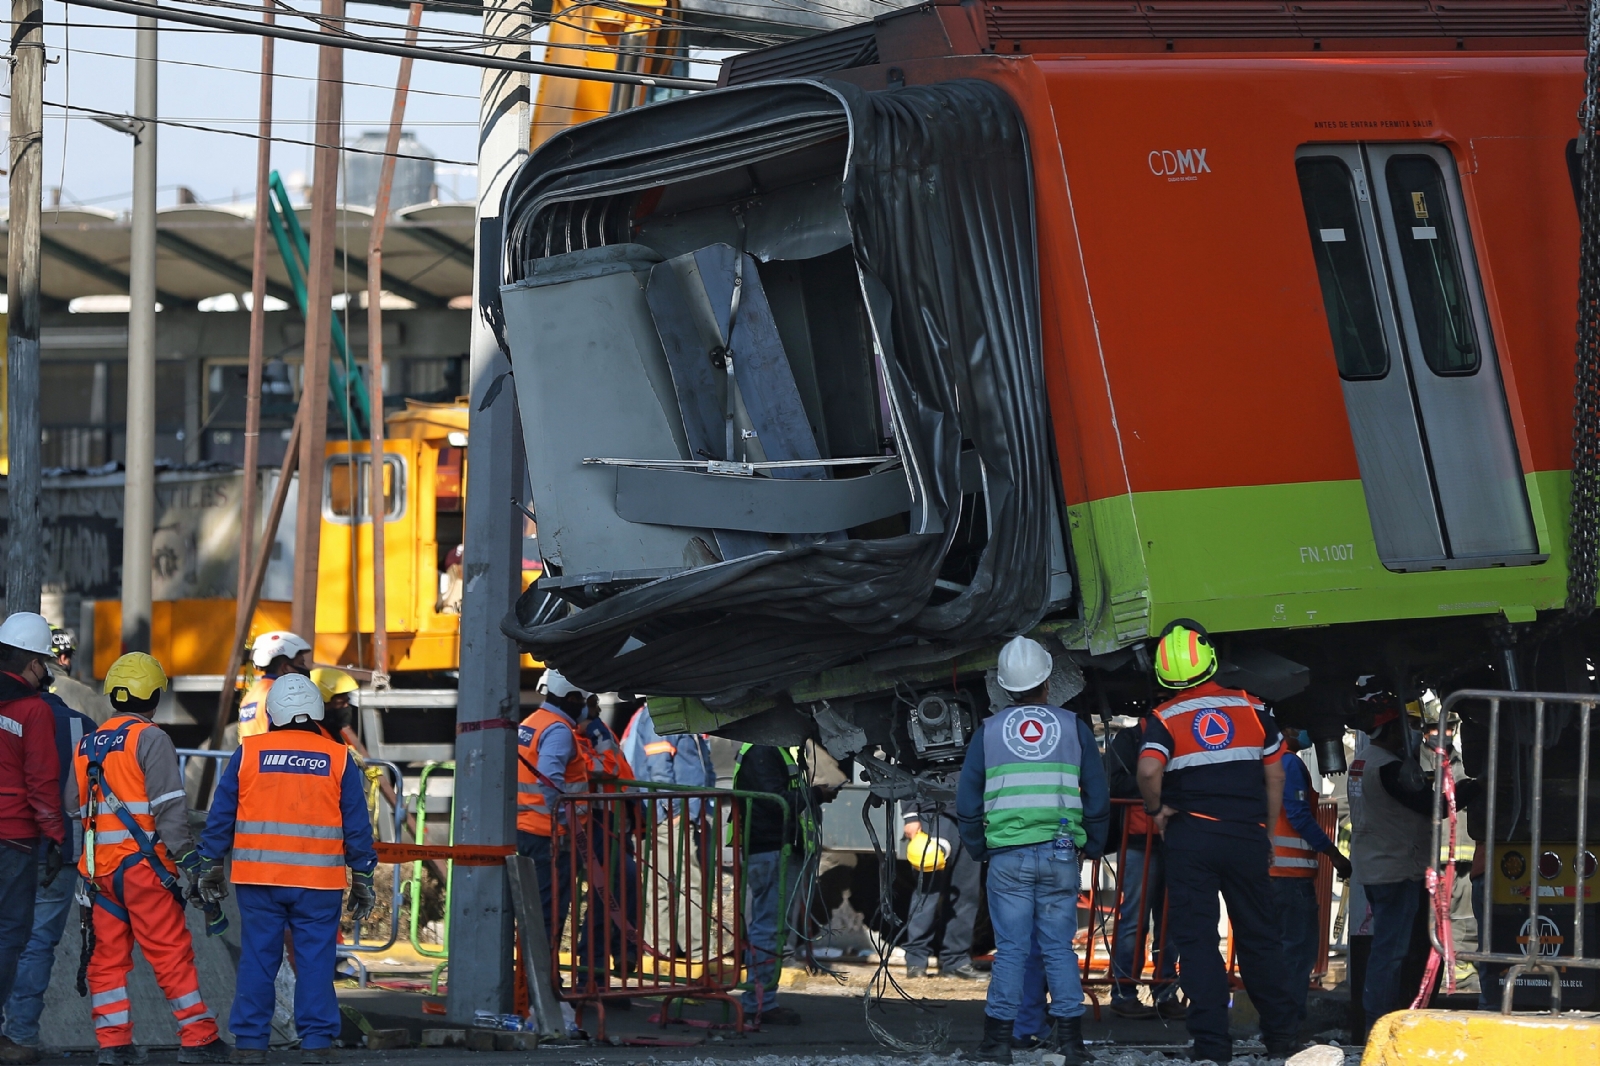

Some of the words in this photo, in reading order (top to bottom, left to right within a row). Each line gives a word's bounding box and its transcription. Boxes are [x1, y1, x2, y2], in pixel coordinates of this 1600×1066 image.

[1314, 121, 1337, 129] ANTES
[1380, 120, 1411, 128] PERMITA
[1148, 148, 1211, 176] CDMX
[1299, 544, 1354, 563] FN.1007
[287, 755, 327, 770] Cargo
